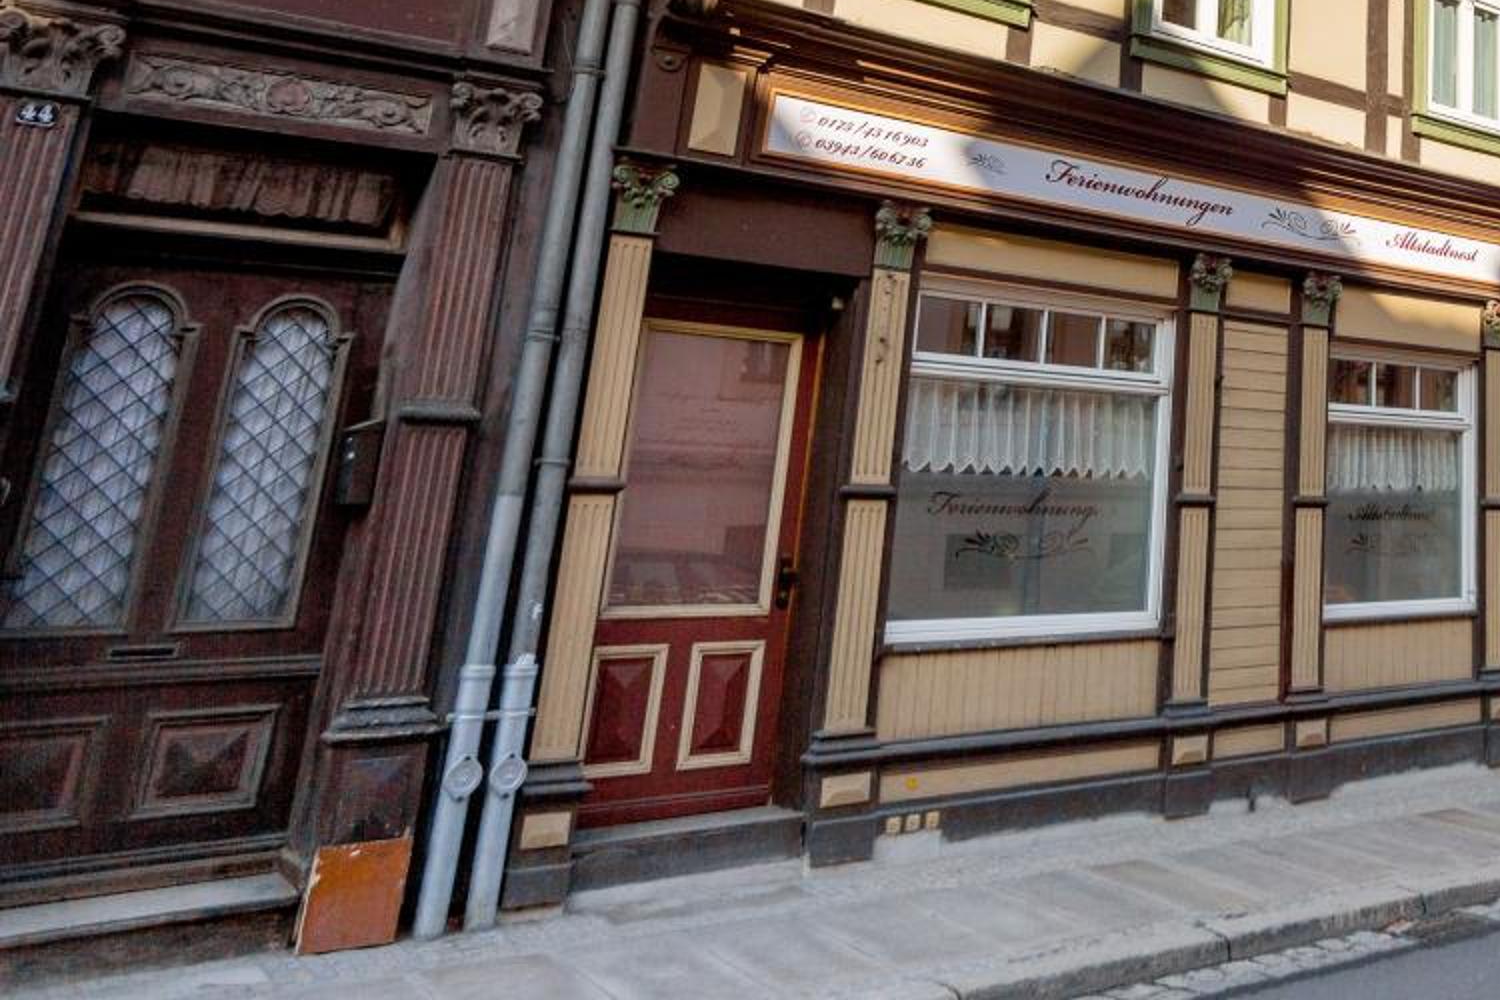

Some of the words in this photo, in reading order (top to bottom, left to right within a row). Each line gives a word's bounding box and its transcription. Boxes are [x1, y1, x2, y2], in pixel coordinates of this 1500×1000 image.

[21, 103, 53, 122] 44
[1045, 158, 1233, 227] Ferienwohnungen
[1385, 230, 1480, 261] Altstadtnest
